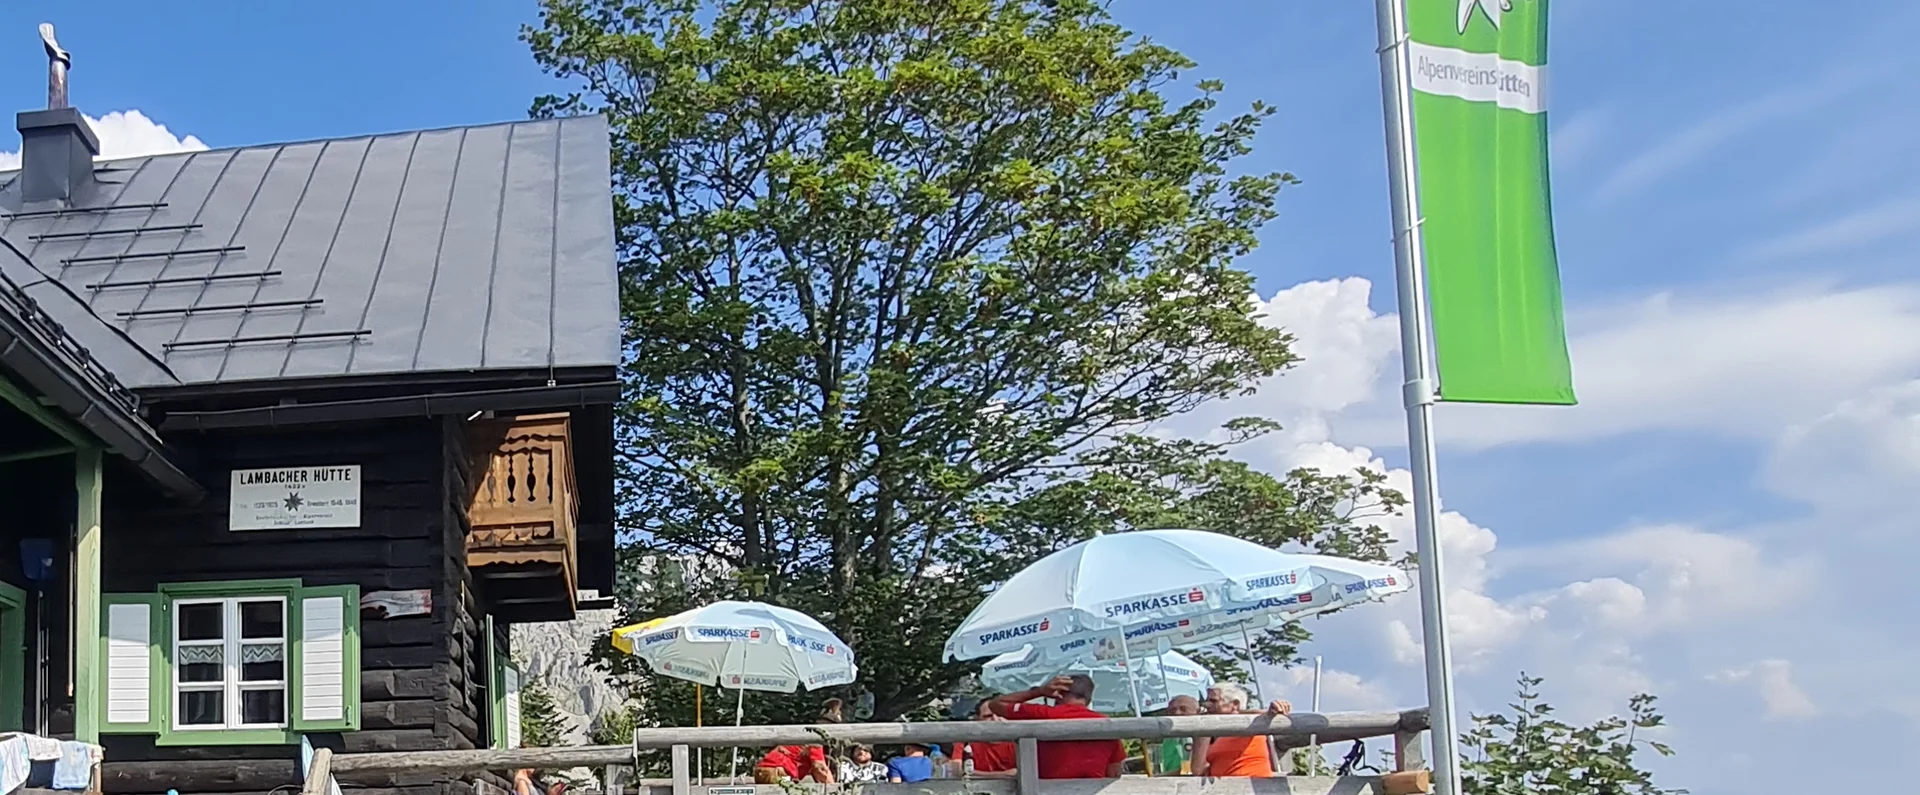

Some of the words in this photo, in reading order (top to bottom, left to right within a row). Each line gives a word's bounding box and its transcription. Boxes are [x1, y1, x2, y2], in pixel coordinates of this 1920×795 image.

[240, 470, 308, 485] LAMBACHER
[313, 468, 352, 482] HÜTTE
[1246, 574, 1290, 591] SPARKASSE
[1105, 594, 1187, 617] SPARKASSE
[697, 628, 750, 639] SPARKASSE
[979, 622, 1039, 645] SPARKASSE
